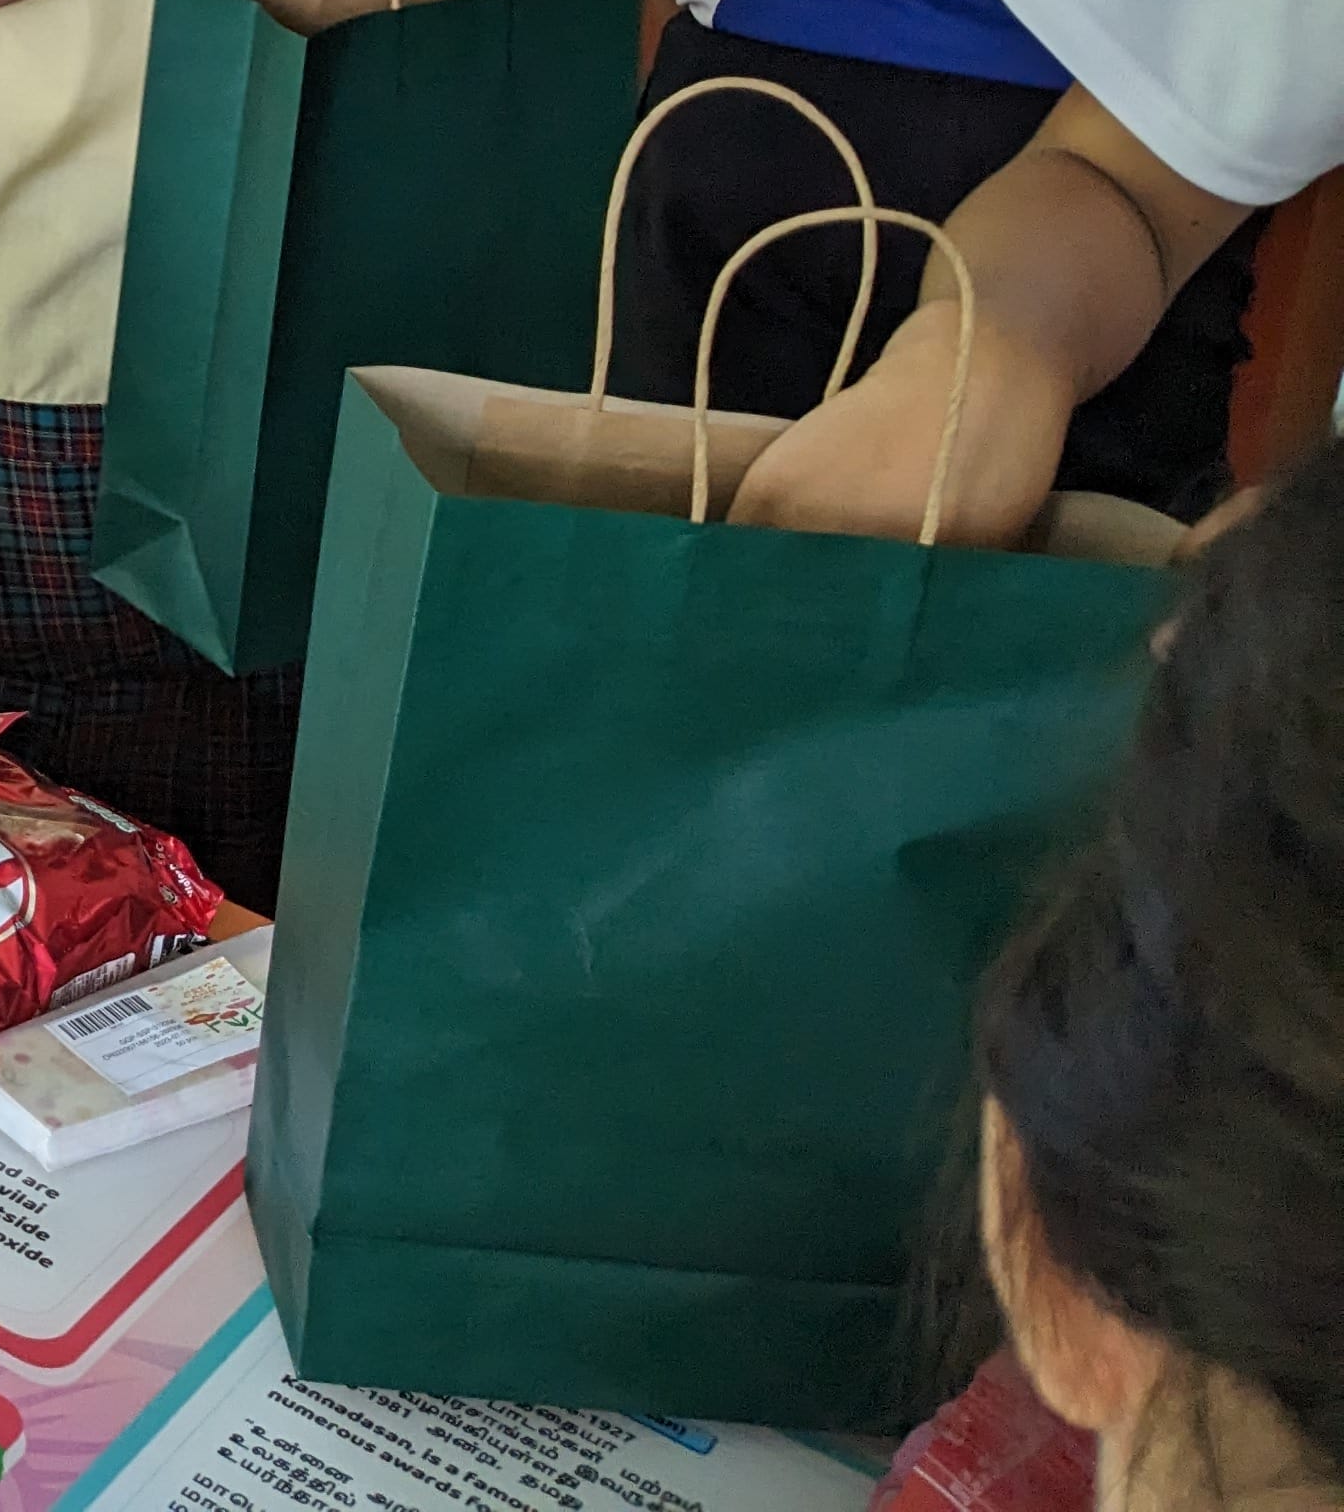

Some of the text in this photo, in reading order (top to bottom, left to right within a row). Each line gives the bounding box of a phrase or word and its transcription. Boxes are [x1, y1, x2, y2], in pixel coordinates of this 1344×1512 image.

[22, 1176, 60, 1201] are
[348, 1385, 412, 1418] -1981
[281, 1374, 416, 1455] Kannadasan,
[421, 1448, 442, 1466] is
[444, 1463, 460, 1475] a
[568, 1408, 638, 1442] -1927
[267, 1389, 493, 1512] numerous awards fo
